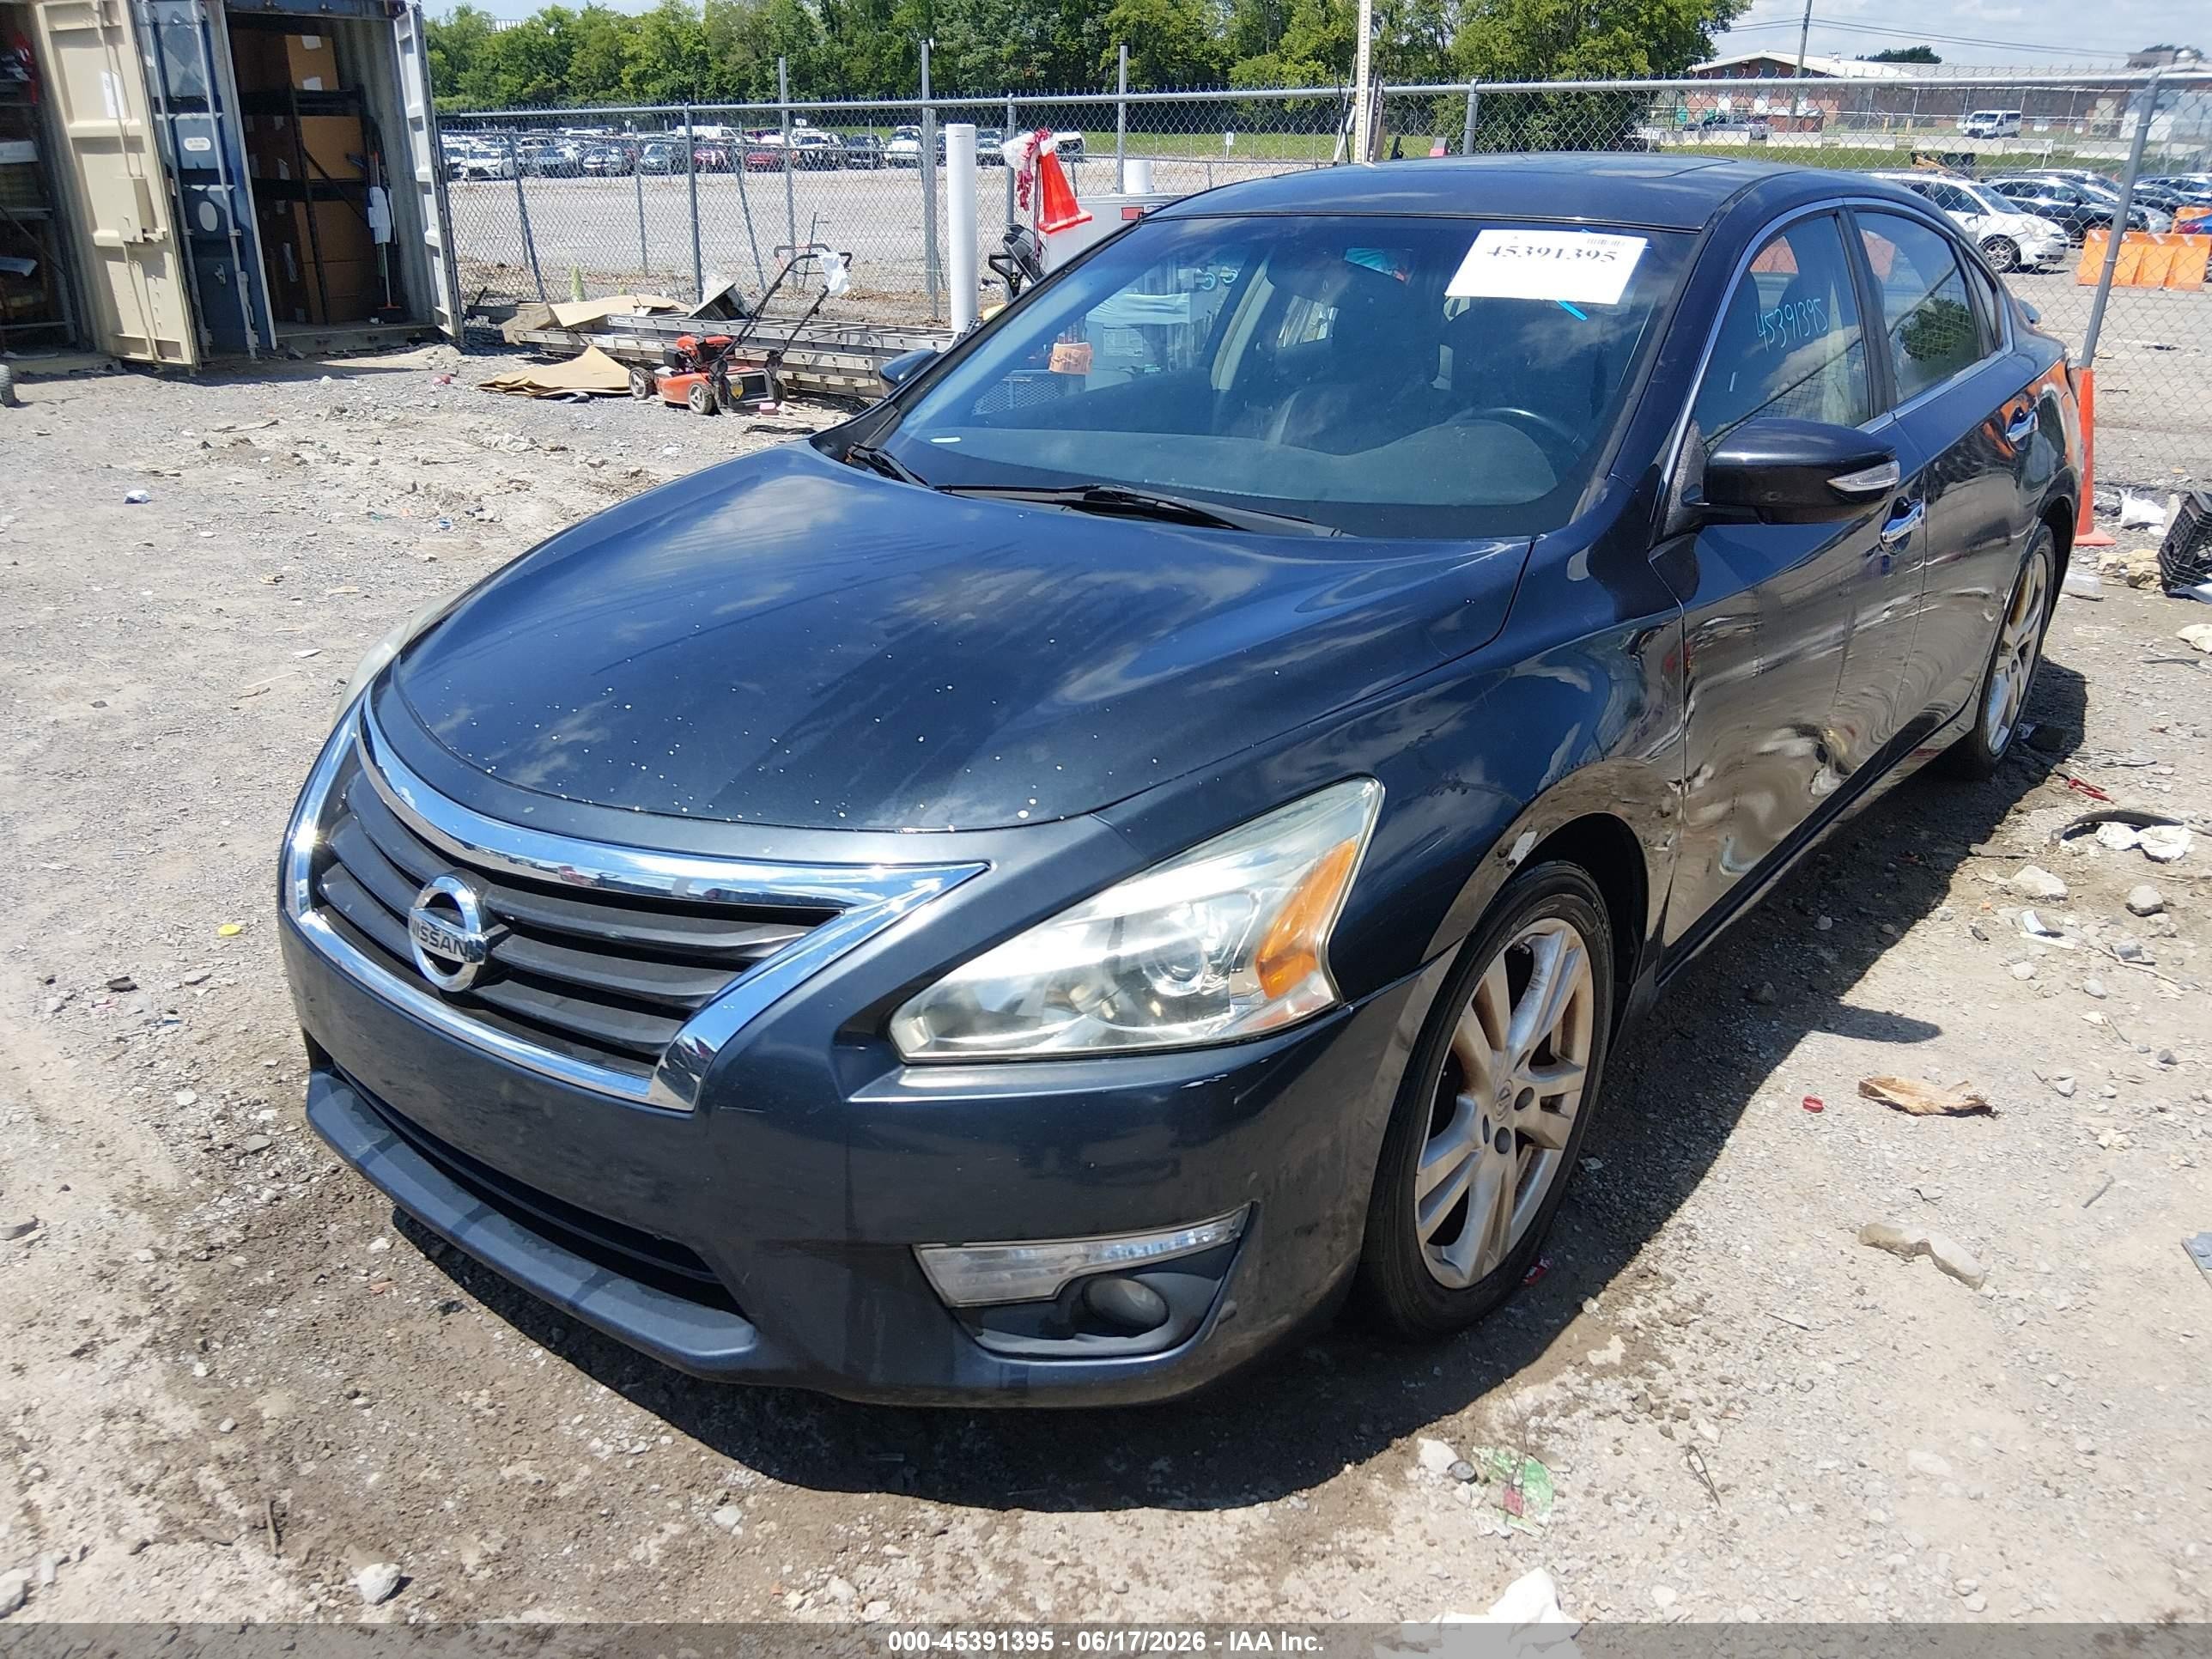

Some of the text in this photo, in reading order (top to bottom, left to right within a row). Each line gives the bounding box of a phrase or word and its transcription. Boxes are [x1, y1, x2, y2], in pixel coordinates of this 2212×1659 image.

[1486, 245, 1618, 263] 45391395
[1755, 299, 1827, 350] 45391395
[410, 918, 469, 957] NISSAN
